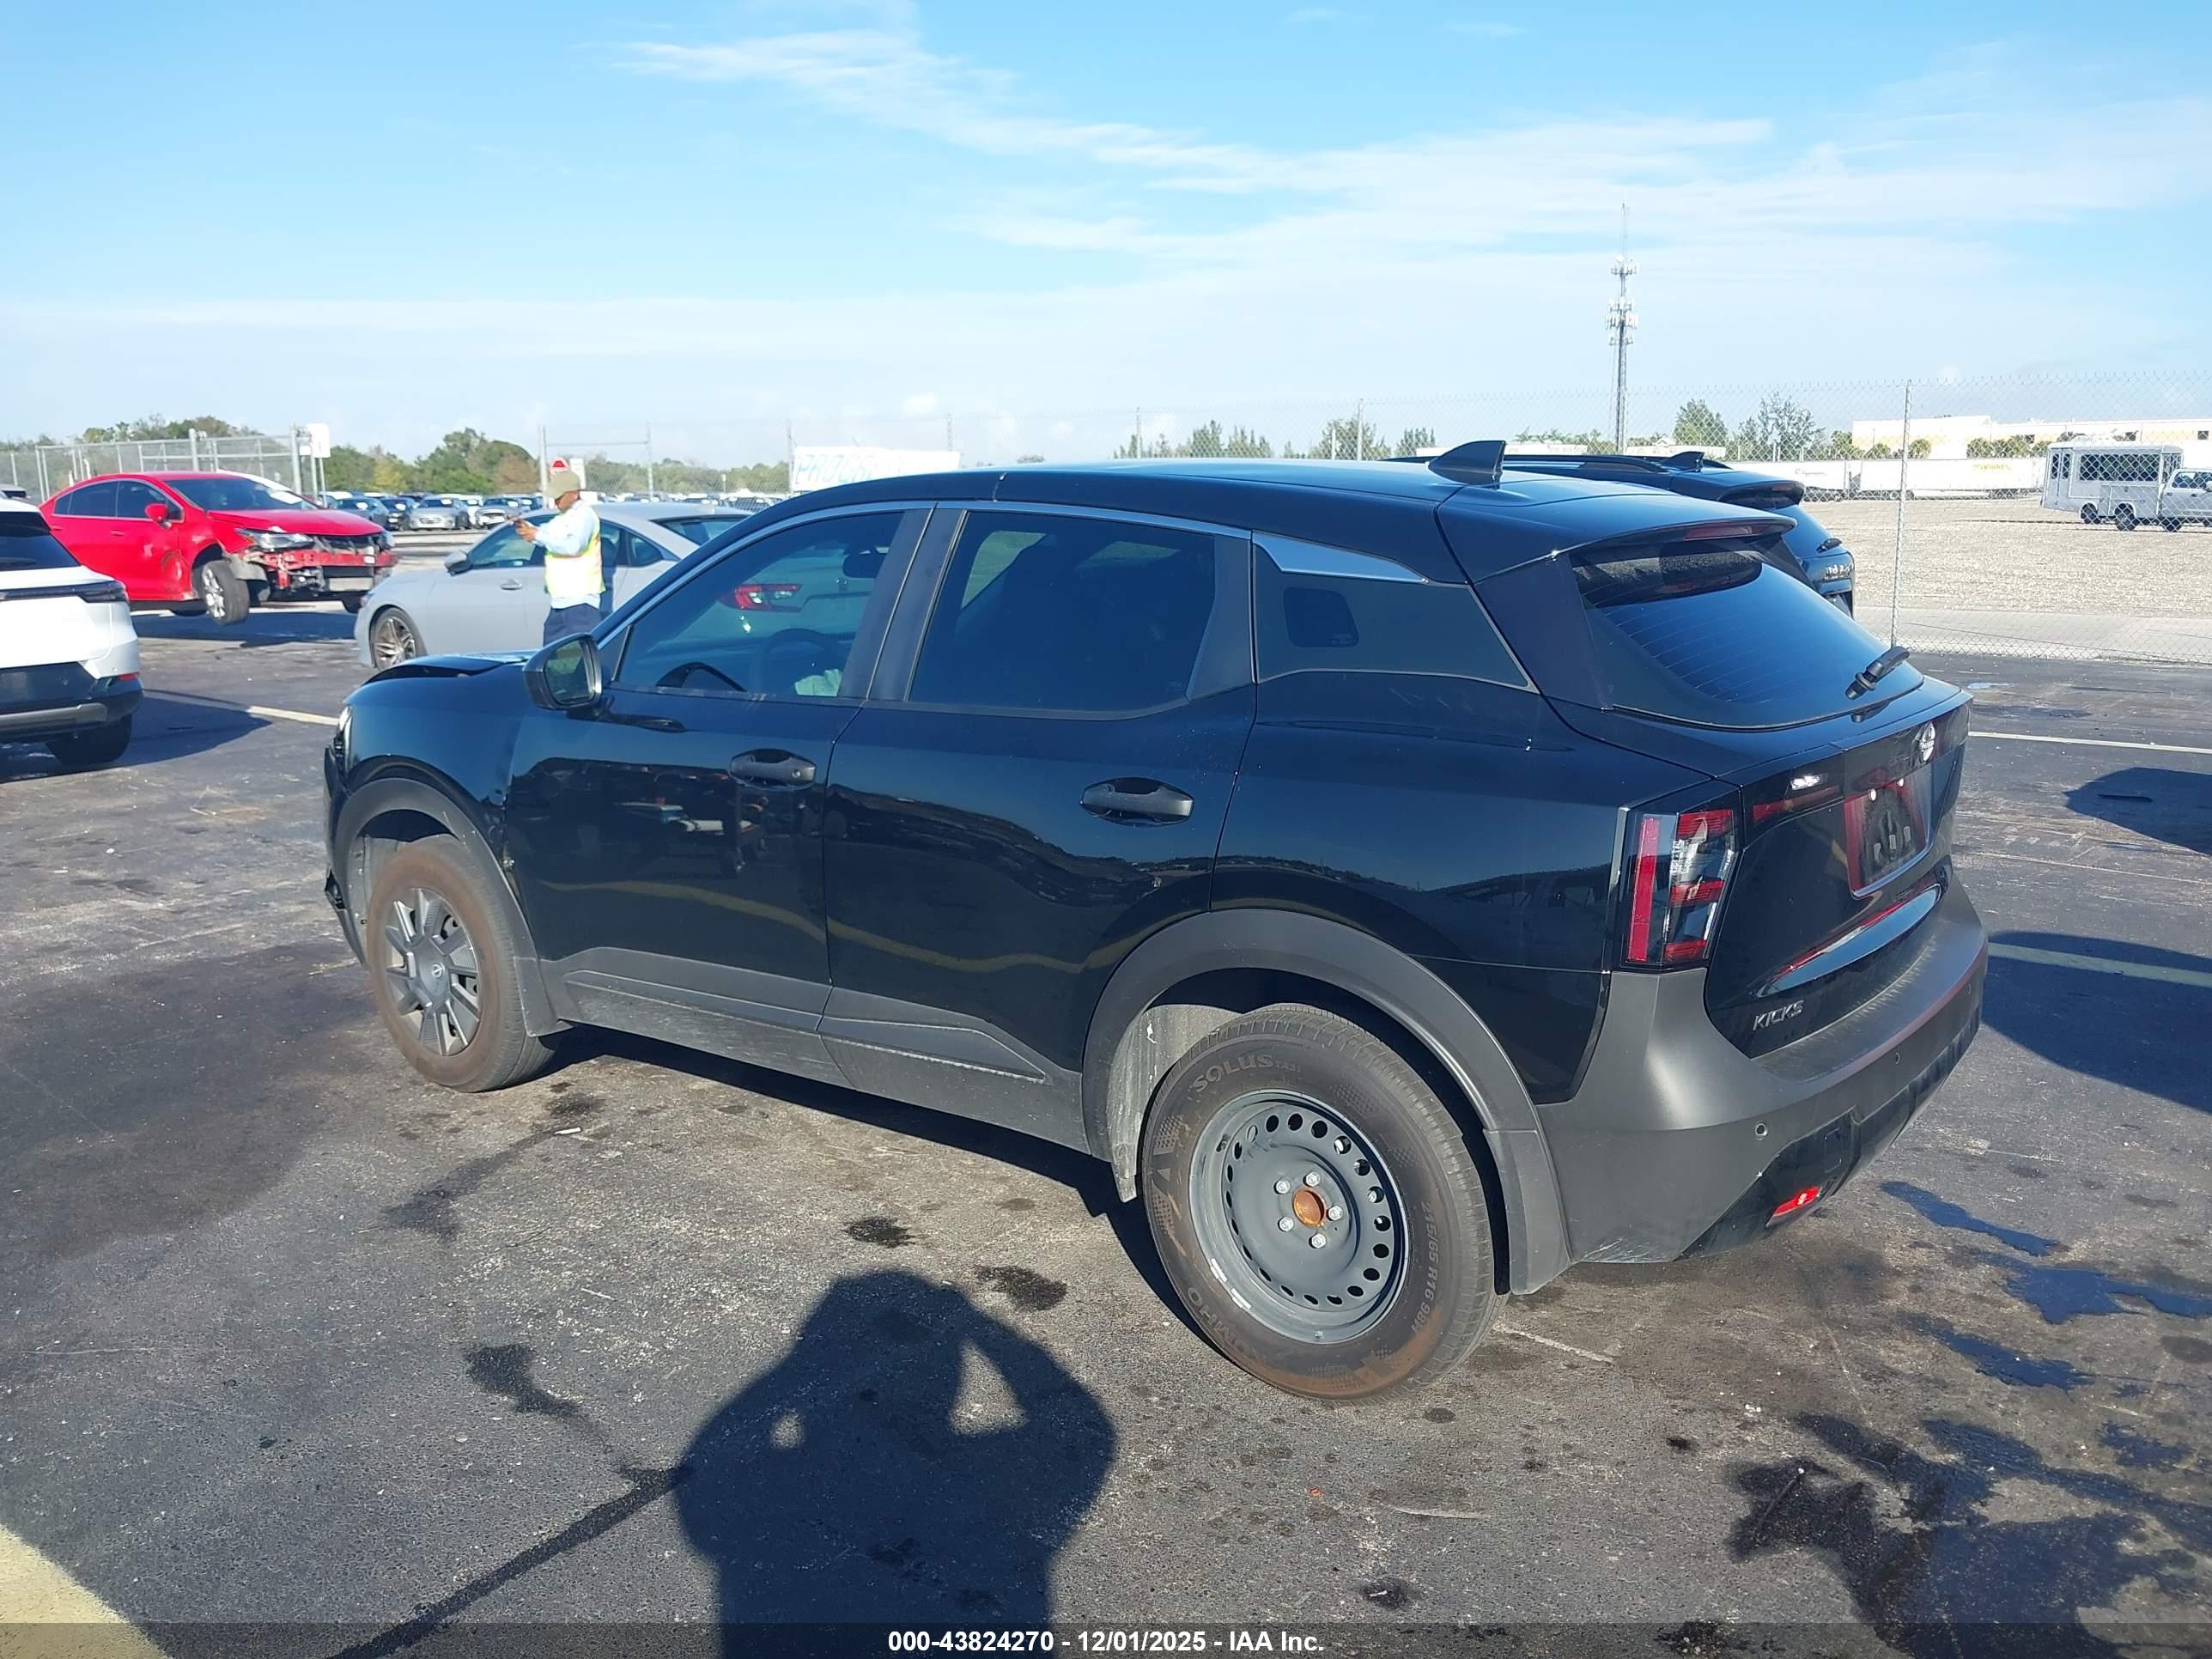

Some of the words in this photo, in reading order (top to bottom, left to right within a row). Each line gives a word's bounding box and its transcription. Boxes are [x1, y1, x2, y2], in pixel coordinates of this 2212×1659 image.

[1753, 1000, 1804, 1031] KICKS
[1193, 1054, 1273, 1093] SOLUS
[1421, 1201, 1439, 1265] 215/65
[1424, 1265, 1439, 1302] R16
